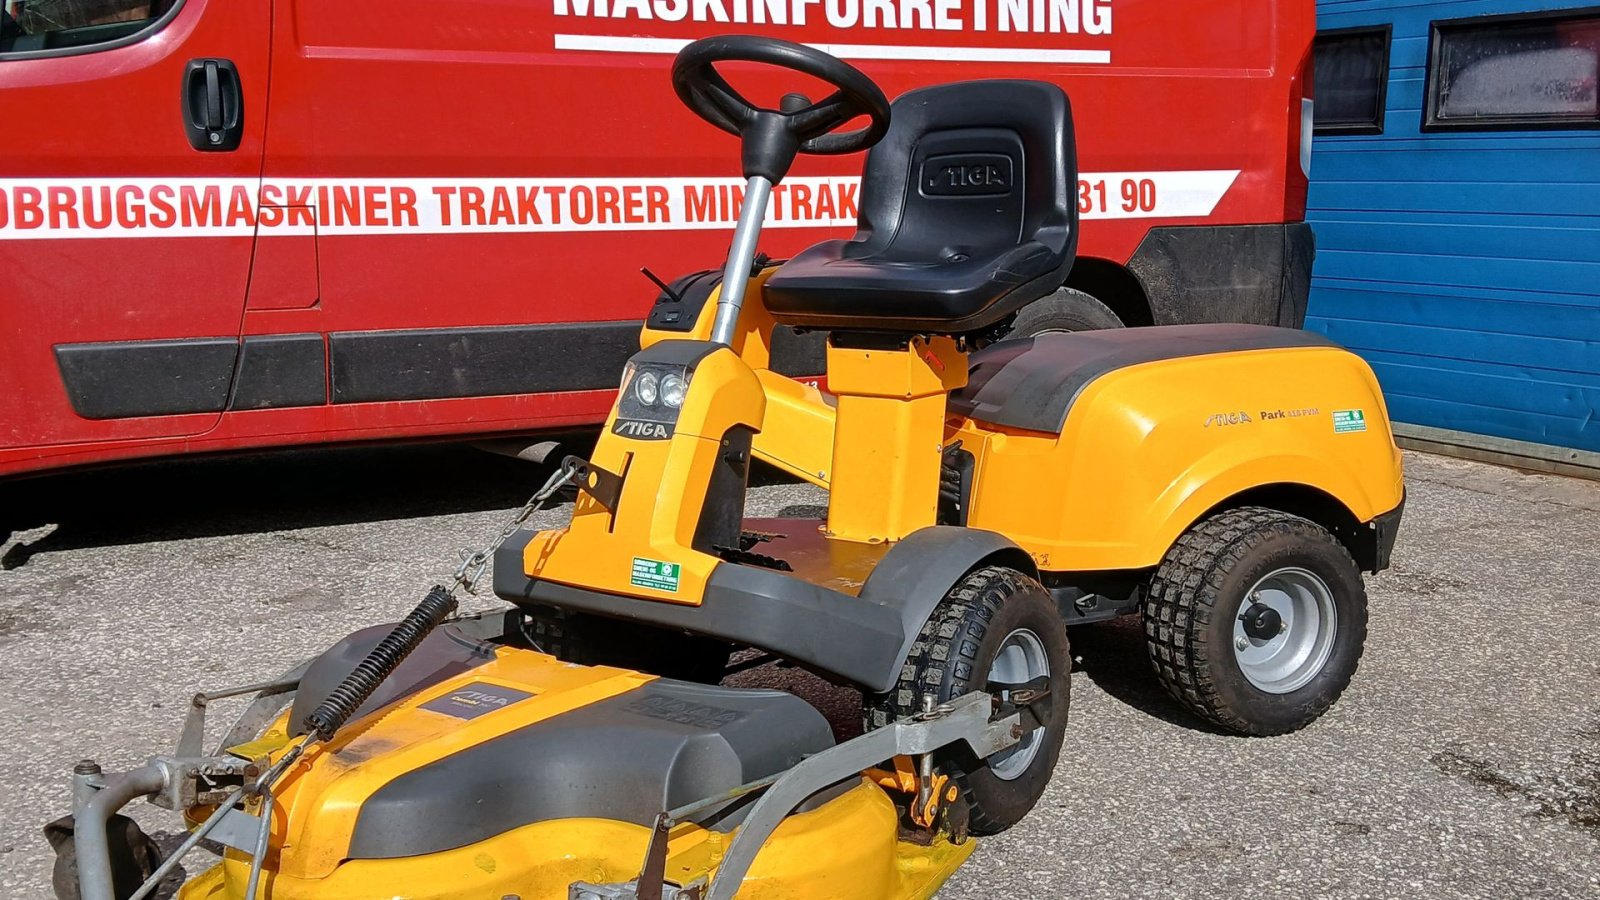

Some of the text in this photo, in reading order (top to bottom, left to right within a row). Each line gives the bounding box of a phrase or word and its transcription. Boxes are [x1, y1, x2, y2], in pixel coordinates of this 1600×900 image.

[554, 0, 1112, 35] ORRETNING
[929, 165, 1005, 187] STIGA
[0, 184, 419, 229] BRUGSMASKINER
[432, 185, 671, 226] TRAKTORER
[683, 183, 858, 222] MITRAK
[1120, 178, 1156, 212] 90
[1204, 411, 1252, 428] STIGA
[1260, 410, 1286, 420] Park
[615, 421, 668, 438] STIGA
[453, 690, 508, 706] STIGA
